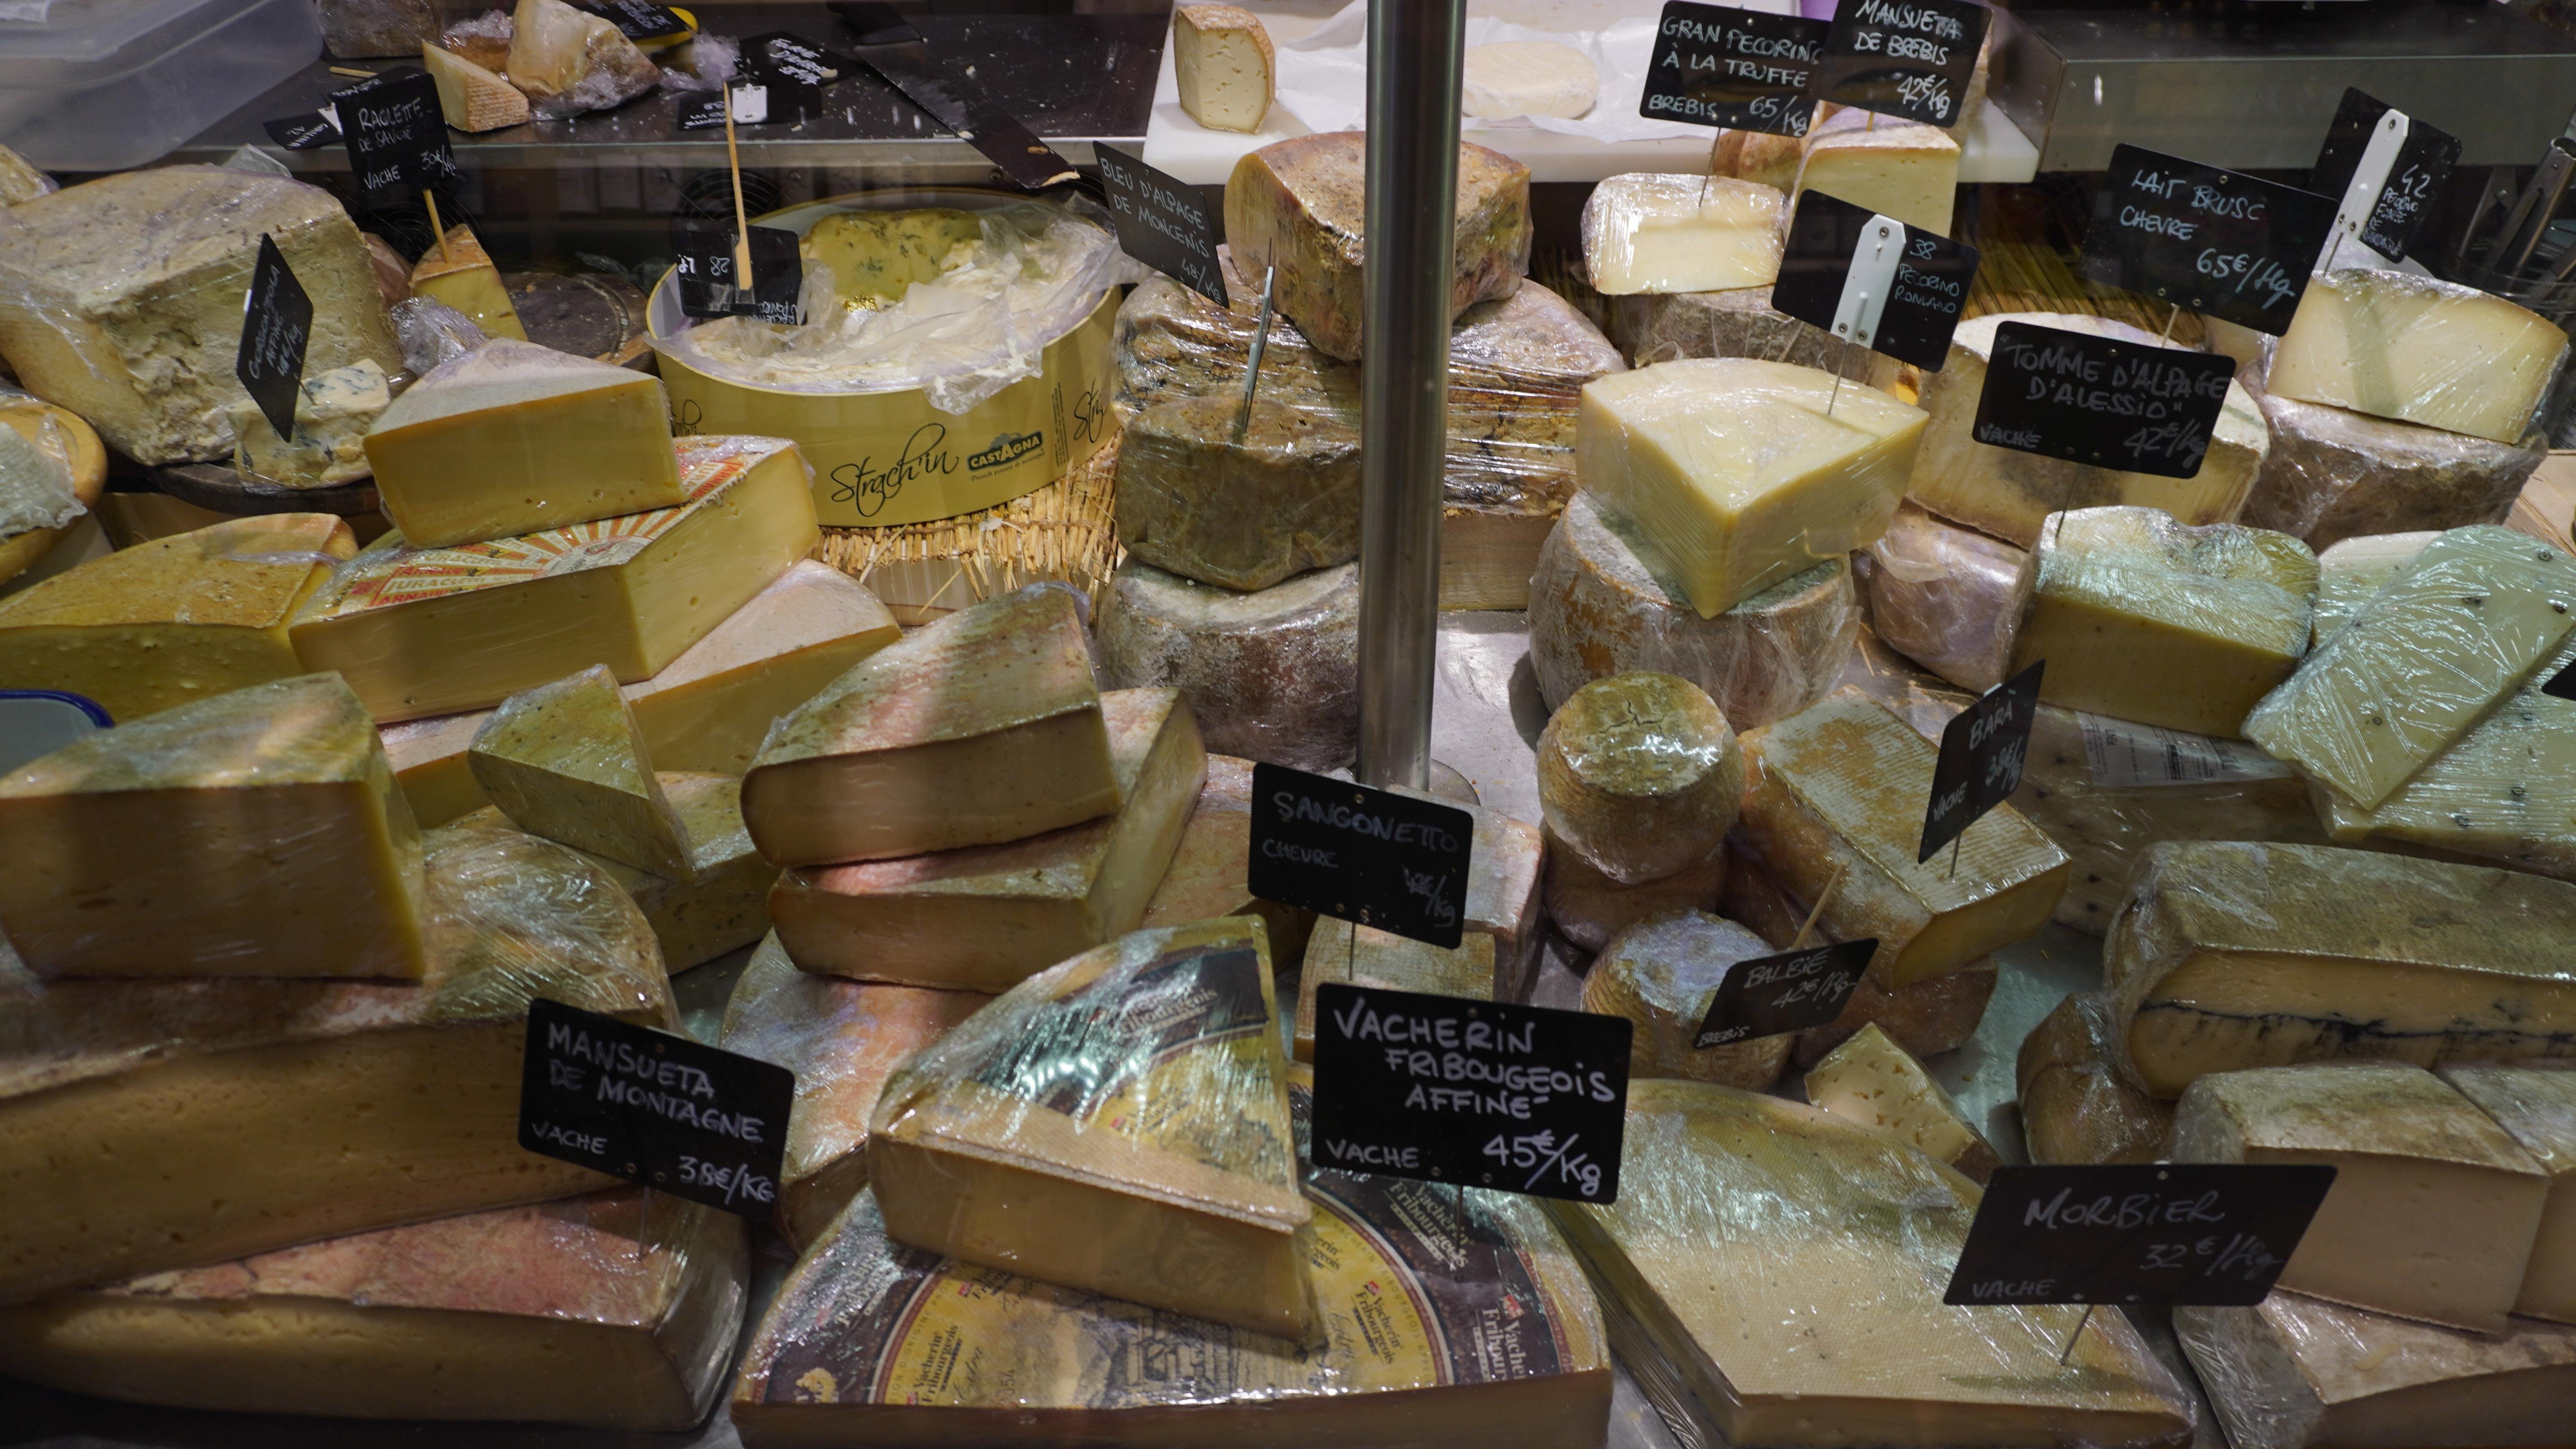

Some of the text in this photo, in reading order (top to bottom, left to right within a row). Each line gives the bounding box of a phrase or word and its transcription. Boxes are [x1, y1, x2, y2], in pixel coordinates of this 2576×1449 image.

[1662, 16, 1721, 43] GRAN
[1855, 0, 1963, 39] MANSUETA
[1854, 31, 1950, 66] DE BREBIS
[1690, 54, 1716, 71] LA
[1724, 59, 1809, 87] TRUFFE
[358, 97, 425, 131] RACLETTE
[1648, 94, 1718, 116] BREBIS
[364, 164, 401, 190] VACHE
[1100, 157, 1205, 230] BLEU D'ALPAGE
[2401, 164, 2430, 198] 42
[1113, 193, 1132, 215] DE
[2120, 205, 2198, 240] CHEVRE
[2111, 359, 2231, 399] D'ALPAGE
[971, 435, 1041, 468] CASTAGNA
[1980, 423, 2042, 449] VACHE
[1969, 700, 2013, 751] BARA
[1273, 791, 1458, 853] SANGONETTO
[1262, 838, 1339, 868] CHEVRE
[1333, 996, 1535, 1054] VACHERIN
[547, 1022, 715, 1099] MANSUETA
[1385, 1049, 1616, 1102] FRIBOUGEOIS
[549, 1058, 765, 1143] DE MONTAGNE
[532, 1121, 608, 1155] VACHE
[1325, 1138, 1419, 1169] VACHE
[2024, 1187, 2226, 1229] MORBIER
[1972, 1279, 2056, 1297] VACHE
[1373, 1296, 1401, 1349] Vacherin
[914, 1331, 943, 1388] Vacherin
